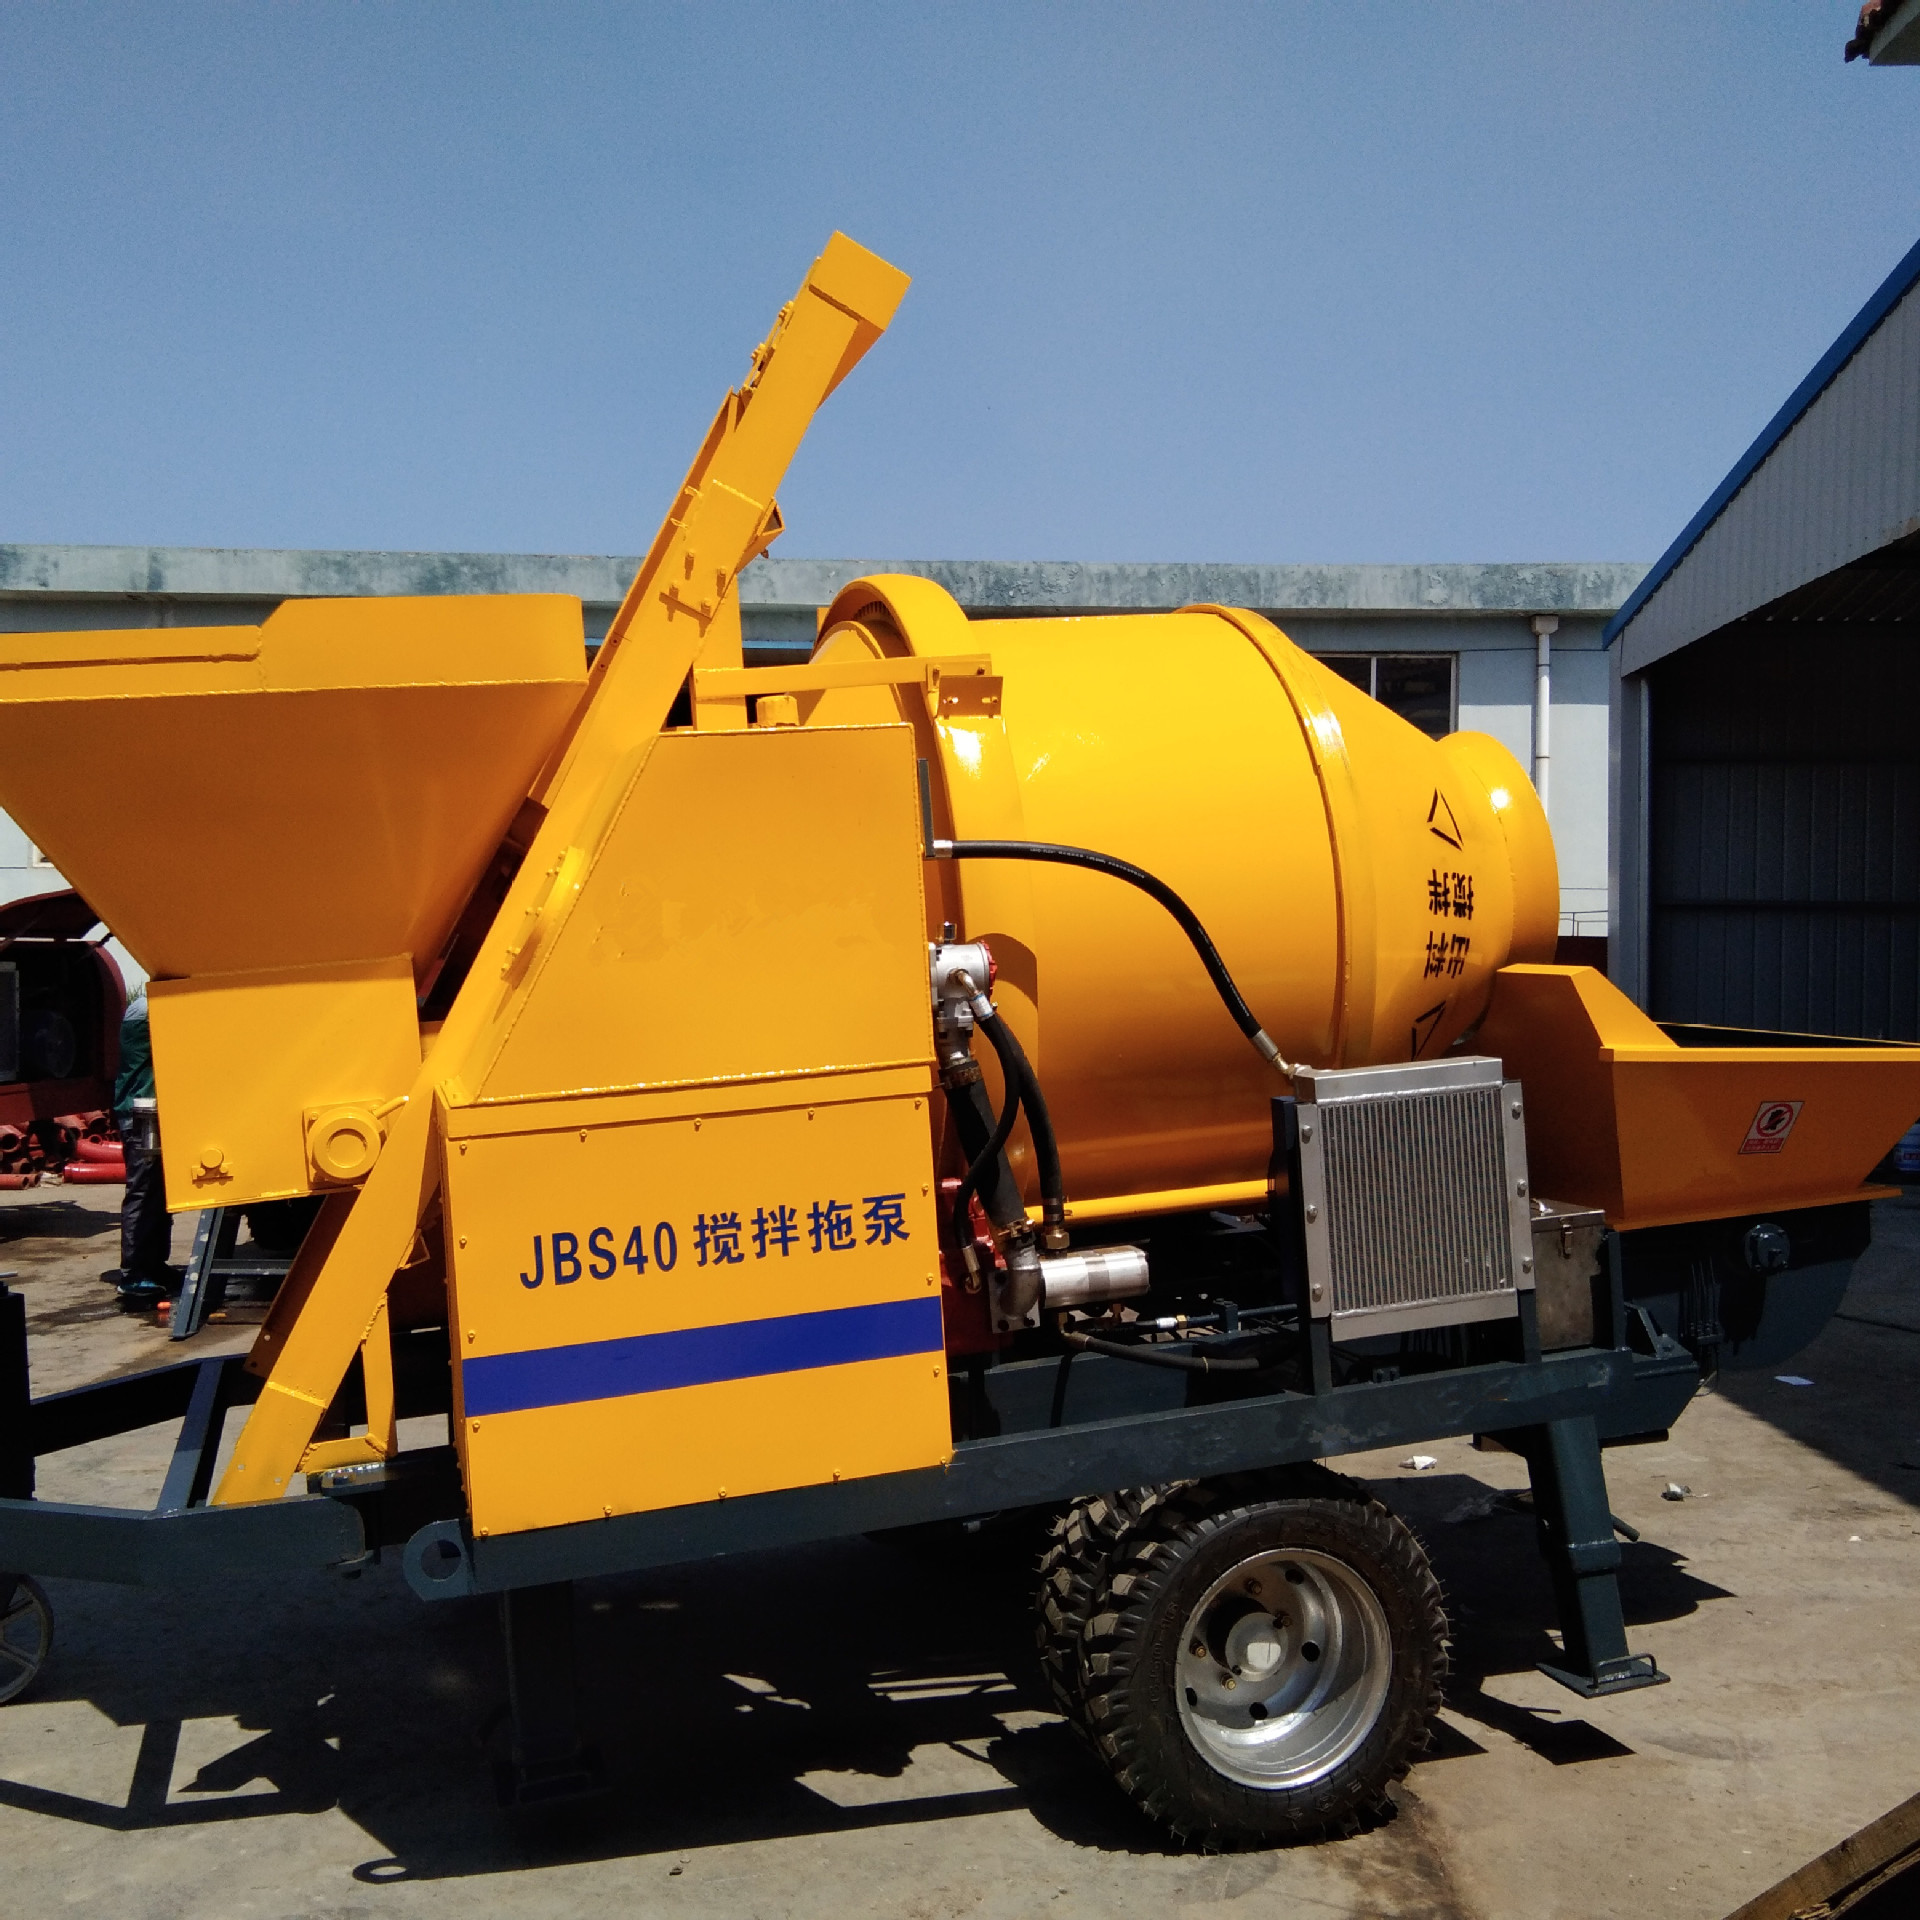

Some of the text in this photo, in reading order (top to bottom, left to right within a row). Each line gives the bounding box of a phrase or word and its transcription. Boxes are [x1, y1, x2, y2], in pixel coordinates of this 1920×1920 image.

[519, 1192, 911, 1290] JBS40 搅拌拖泵
